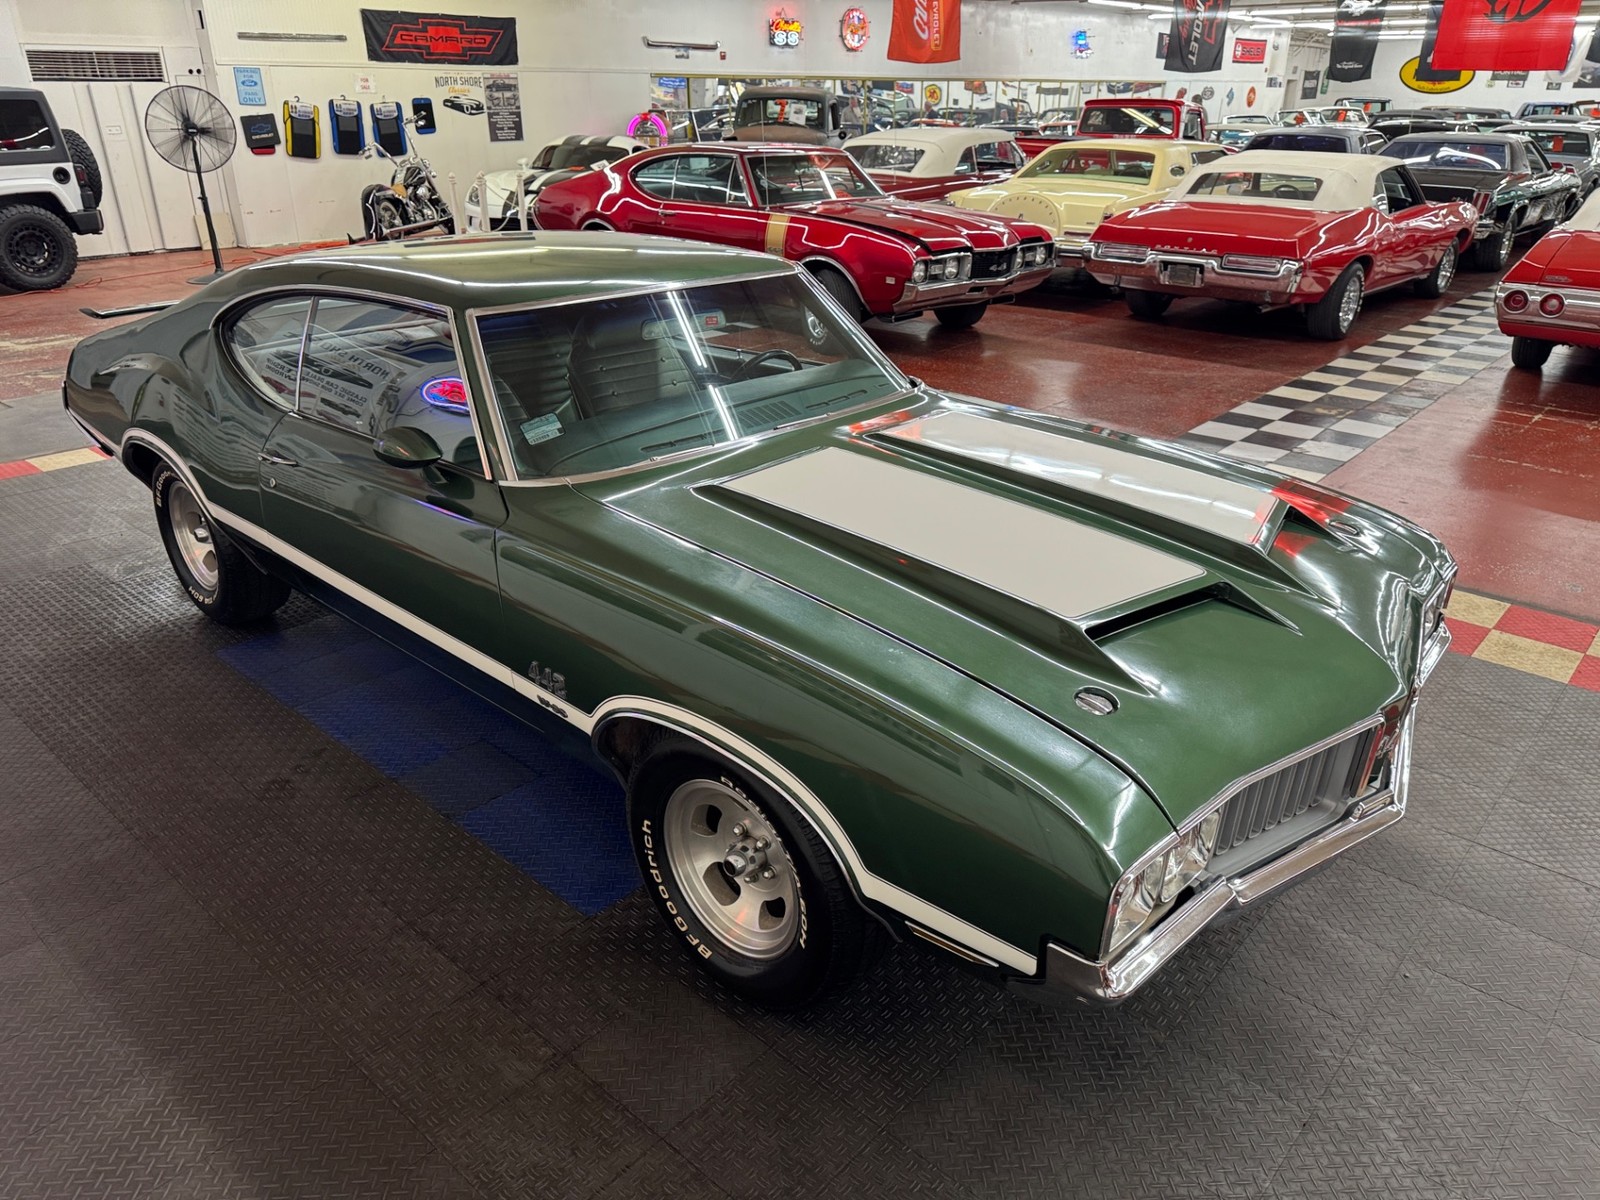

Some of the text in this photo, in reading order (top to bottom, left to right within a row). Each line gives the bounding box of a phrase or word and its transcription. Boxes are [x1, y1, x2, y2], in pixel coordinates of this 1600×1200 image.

[400, 33, 487, 46] CAMARO
[774, 31, 799, 46] SS
[434, 75, 459, 89] NORTH
[459, 75, 483, 89] SHORE
[642, 818, 713, 960] BFGoodrich
